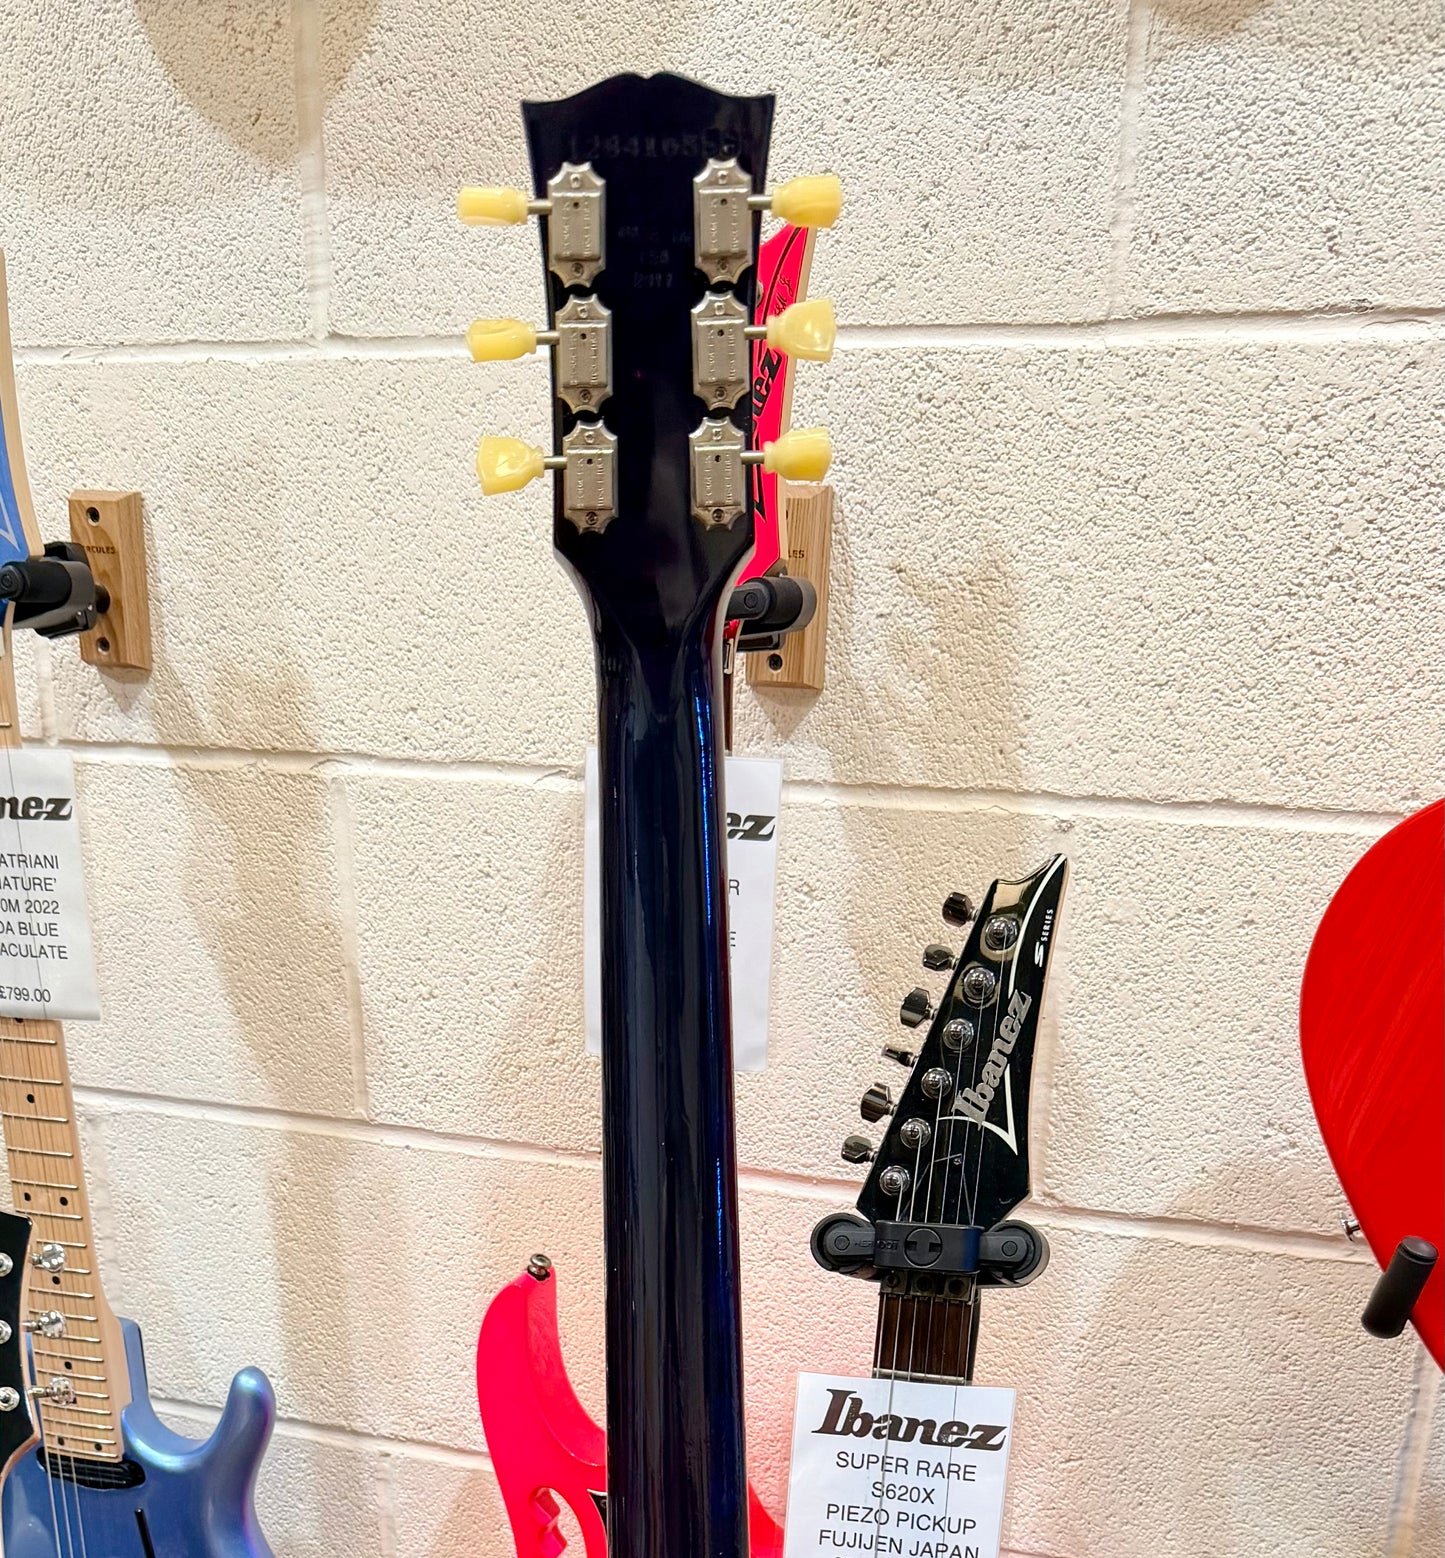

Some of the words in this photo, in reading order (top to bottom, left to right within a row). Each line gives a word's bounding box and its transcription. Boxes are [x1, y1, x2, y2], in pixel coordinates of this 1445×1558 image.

[83, 545, 117, 555] RCULES
[0, 796, 72, 821] nez
[0, 853, 59, 869] ATRIANI
[0, 876, 57, 892] ATURE'
[25, 899, 60, 915] 2022
[18, 921, 59, 937] BLUE
[1040, 908, 1054, 942] SERIES
[0, 942, 68, 960] ACULATE
[0, 985, 51, 1003] £799.00
[951, 988, 1032, 1131] Ibanez
[811, 1388, 1007, 1452] Ibanez
[836, 1451, 910, 1475] SUPER
[916, 1460, 977, 1482] RARE
[871, 1481, 936, 1505] S620X
[826, 1503, 889, 1526] PIEZO
[896, 1511, 977, 1536] PICKUP
[818, 1530, 903, 1554] FUJIJEN
